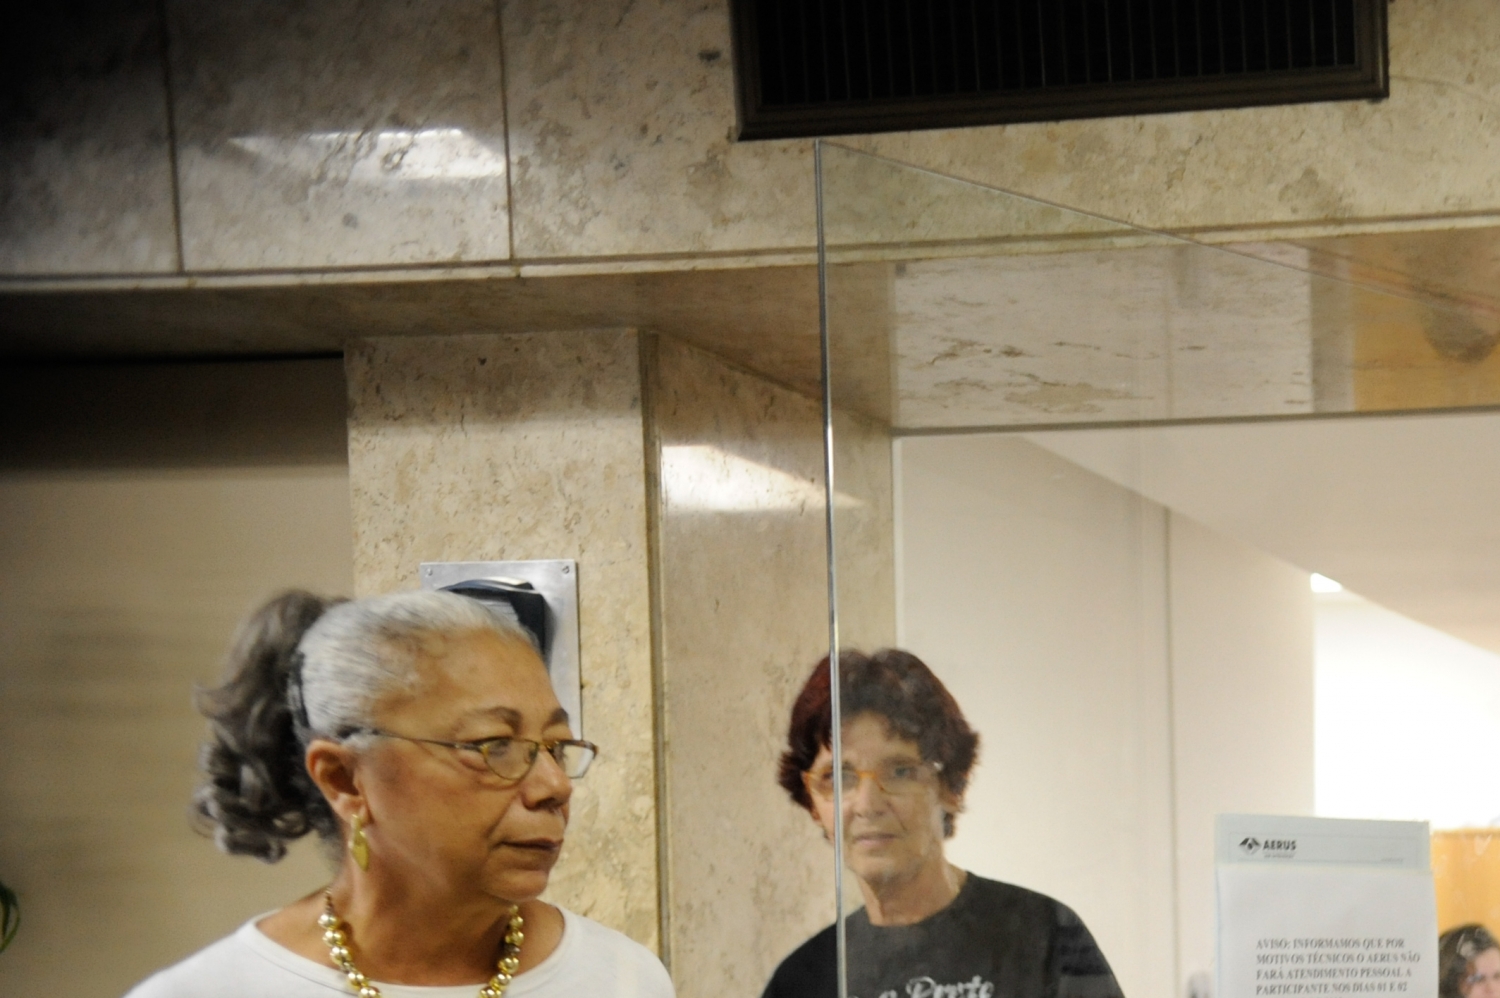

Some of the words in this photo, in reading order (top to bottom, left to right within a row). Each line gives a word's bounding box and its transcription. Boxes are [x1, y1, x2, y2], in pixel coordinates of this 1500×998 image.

[1263, 840, 1296, 850] AERUS
[1293, 938, 1361, 949] INFORMAMOS
[1362, 938, 1384, 950] QUE
[1385, 938, 1405, 948] POR
[1257, 953, 1304, 964] MOTIVOS
[1307, 950, 1355, 964] TÉCNICOS
[1356, 953, 1365, 963] O
[1366, 953, 1399, 963] AERUS
[1400, 950, 1421, 962] NÃO
[1256, 966, 1284, 980] FARÁ
[1286, 968, 1358, 979] ATENDIMENTO
[1360, 967, 1404, 978] PESSOAL
[1405, 968, 1412, 977] A
[1256, 983, 1330, 995] PARTICIPANTE
[1332, 982, 1351, 993] NOS
[1352, 982, 1376, 993] DIAS
[1389, 982, 1396, 992] E
